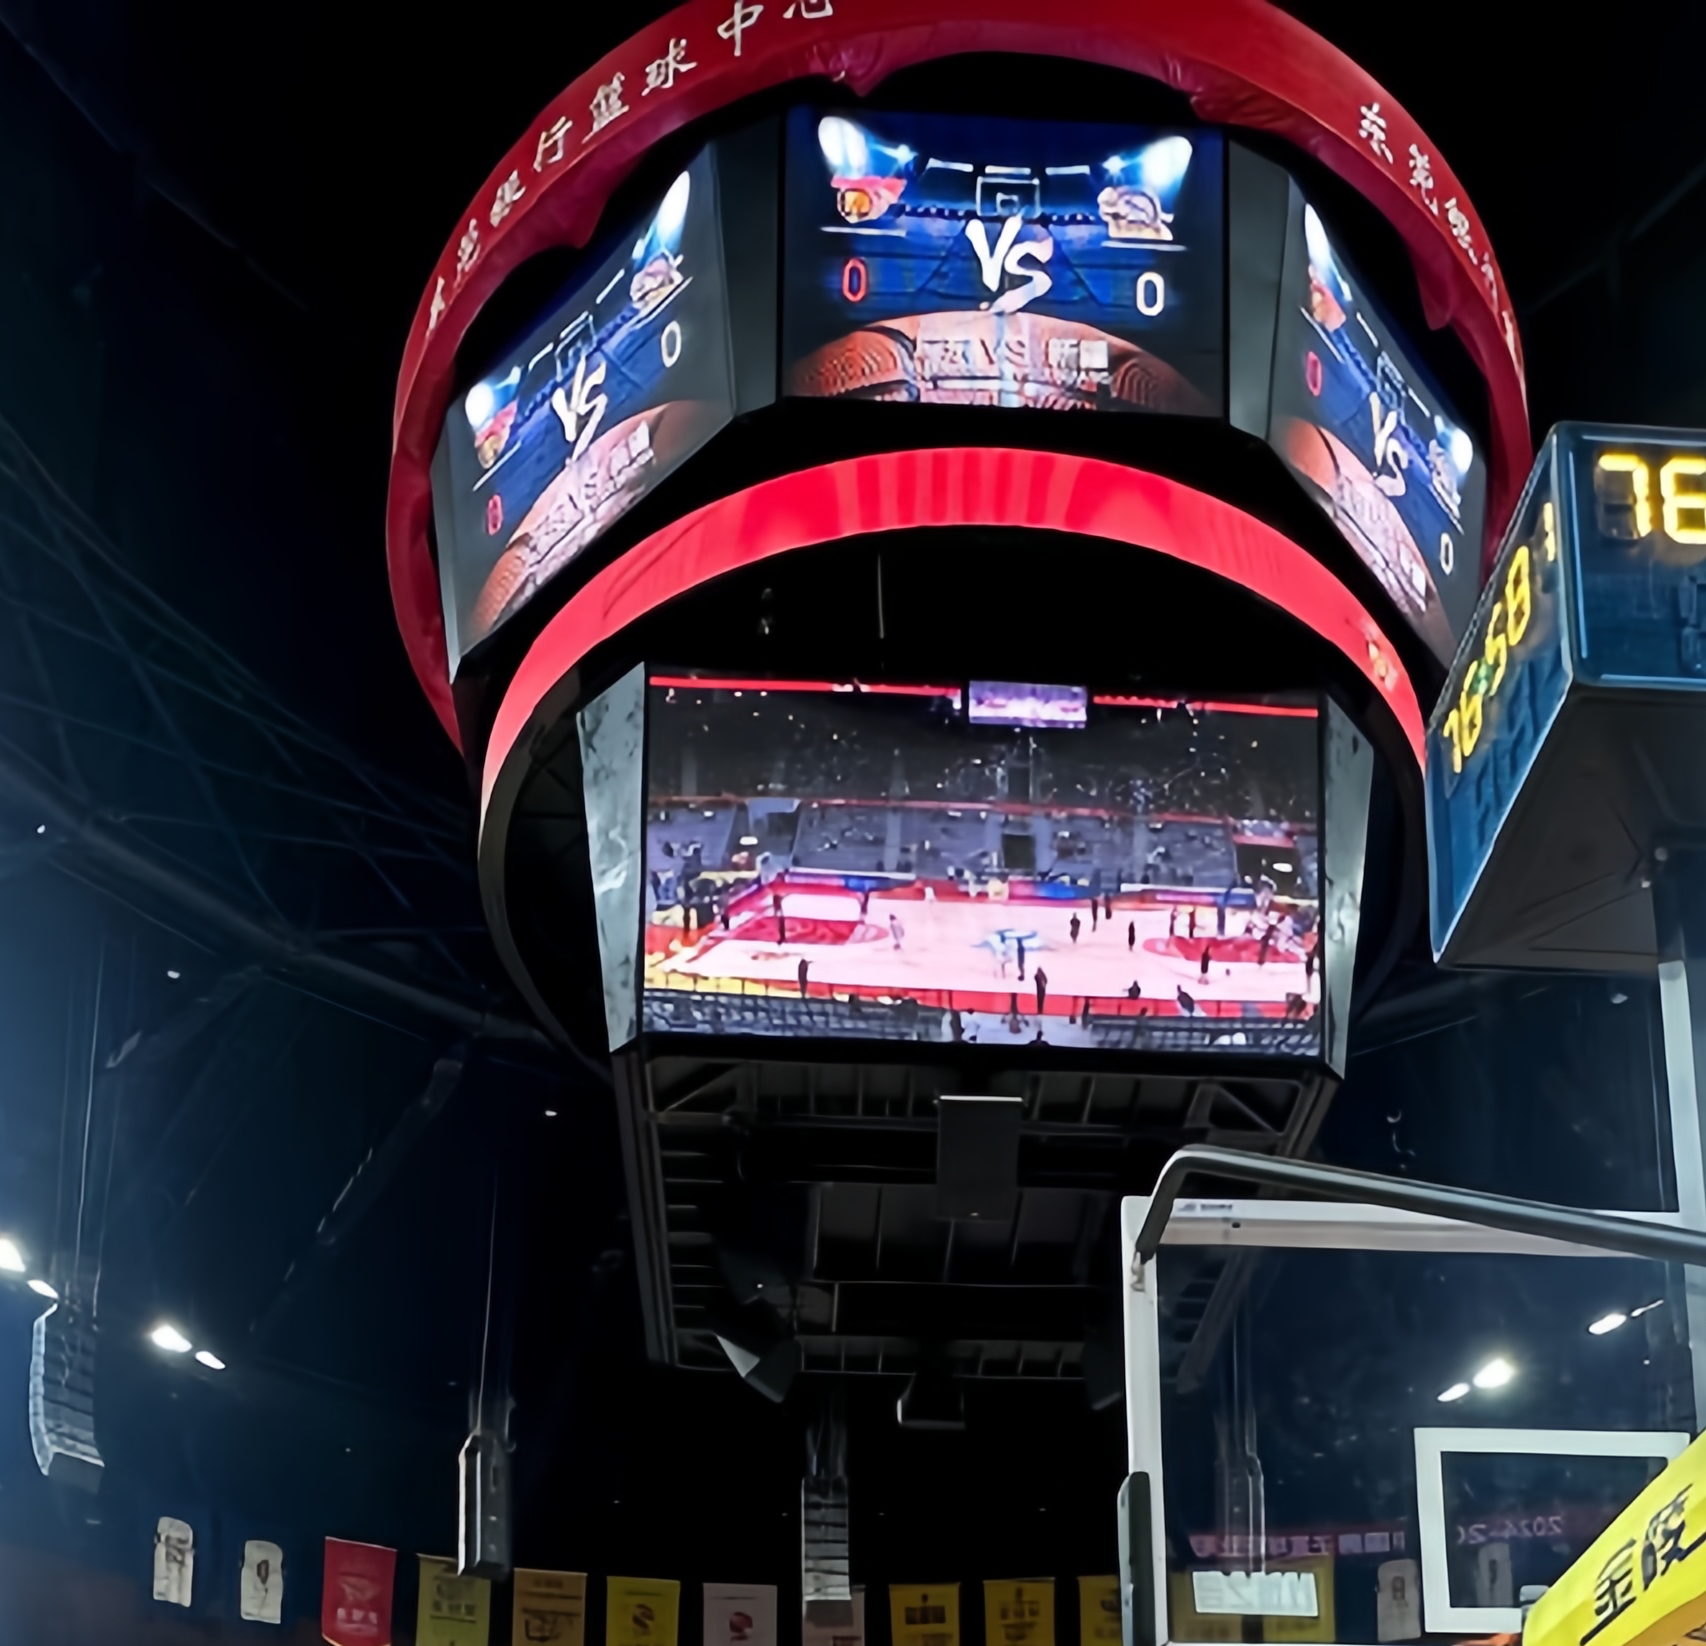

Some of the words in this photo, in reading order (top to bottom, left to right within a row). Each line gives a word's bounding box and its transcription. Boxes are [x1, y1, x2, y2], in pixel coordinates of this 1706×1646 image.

[841, 257, 869, 303] 0
[1135, 271, 1166, 317] 0
[965, 208, 1054, 314] VS
[660, 320, 682, 368] 0
[551, 344, 609, 466] VS
[1439, 532, 1454, 576] 0
